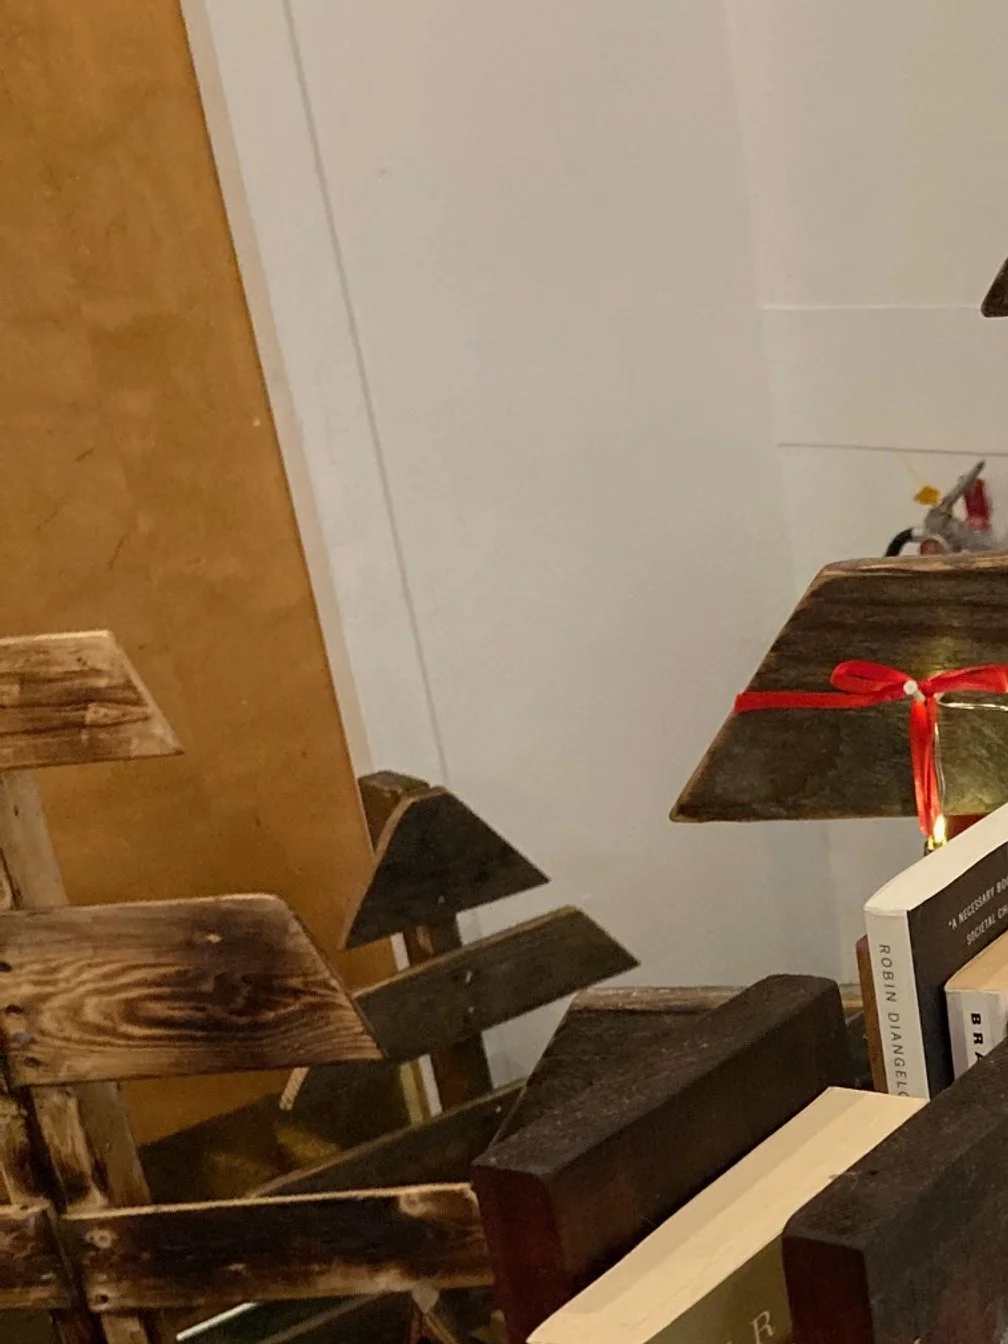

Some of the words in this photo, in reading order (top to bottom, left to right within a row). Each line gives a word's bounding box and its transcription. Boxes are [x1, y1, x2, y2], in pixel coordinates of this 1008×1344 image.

[958, 884, 996, 925] NECESSARY
[966, 914, 997, 946] SOCIETAL
[879, 943, 898, 1003] ROBIN
